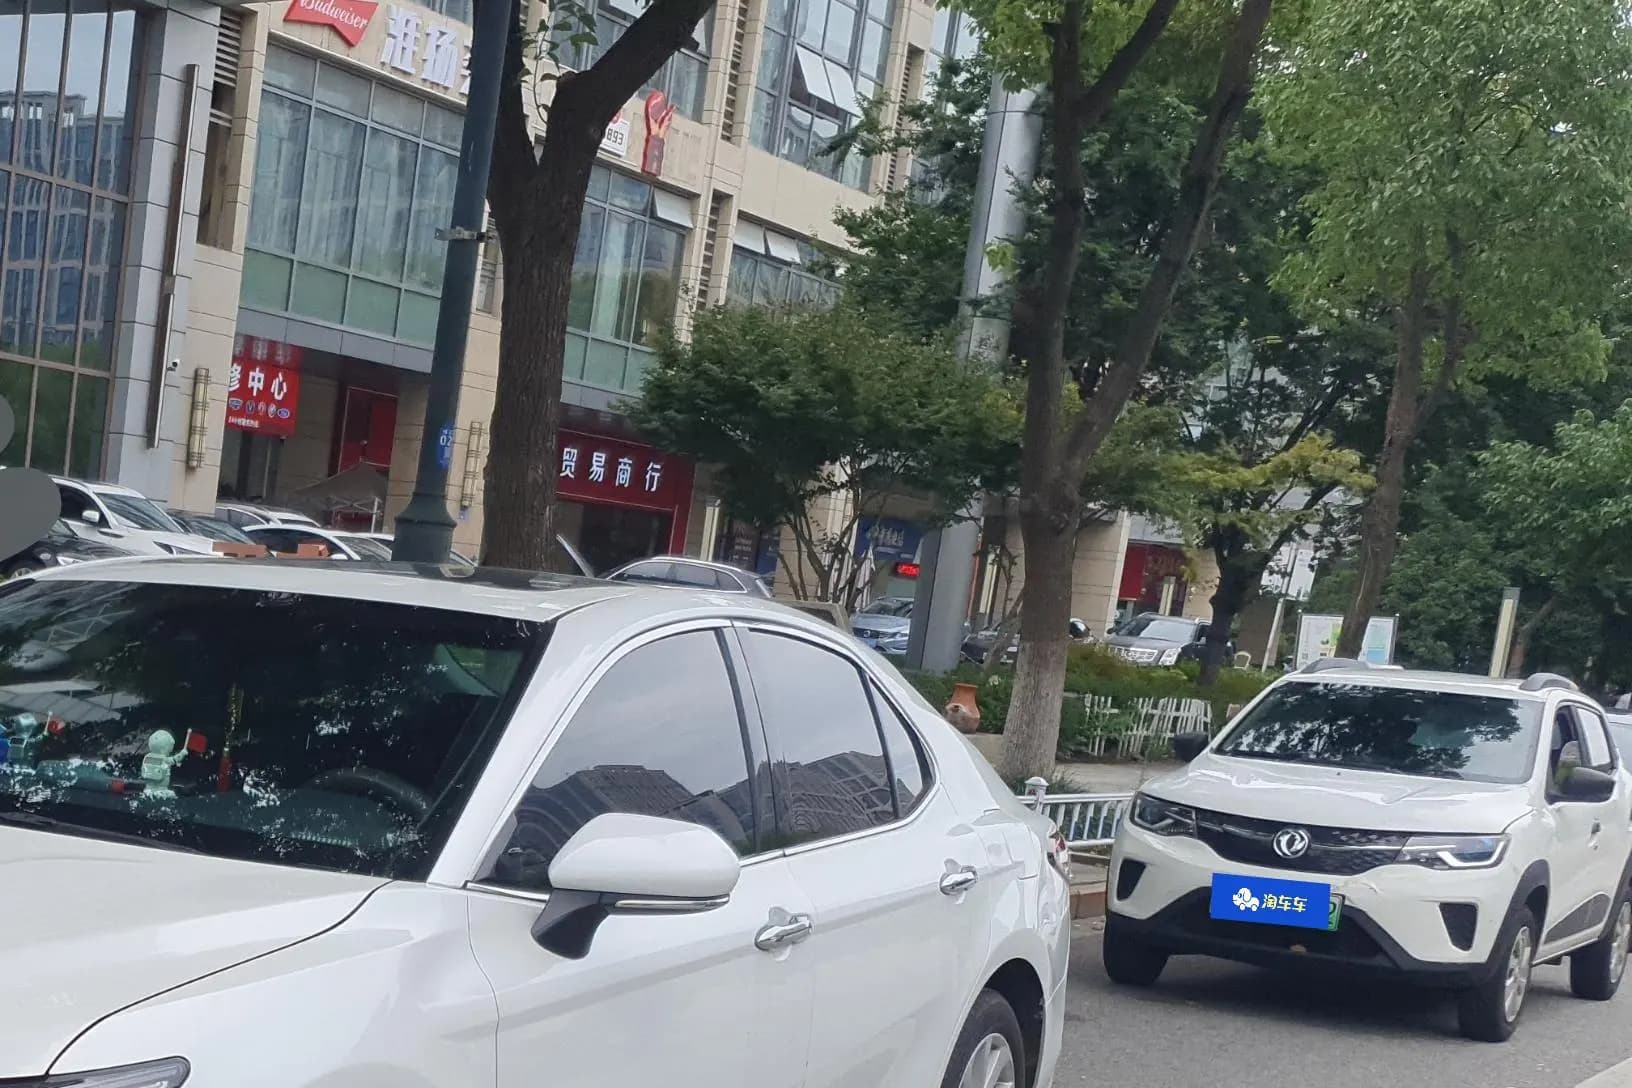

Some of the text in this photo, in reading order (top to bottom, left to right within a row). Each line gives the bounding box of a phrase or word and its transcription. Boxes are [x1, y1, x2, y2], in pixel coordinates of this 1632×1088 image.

[380, 4, 472, 94] 淮扬
[559, 447, 662, 492] 贸易商行
